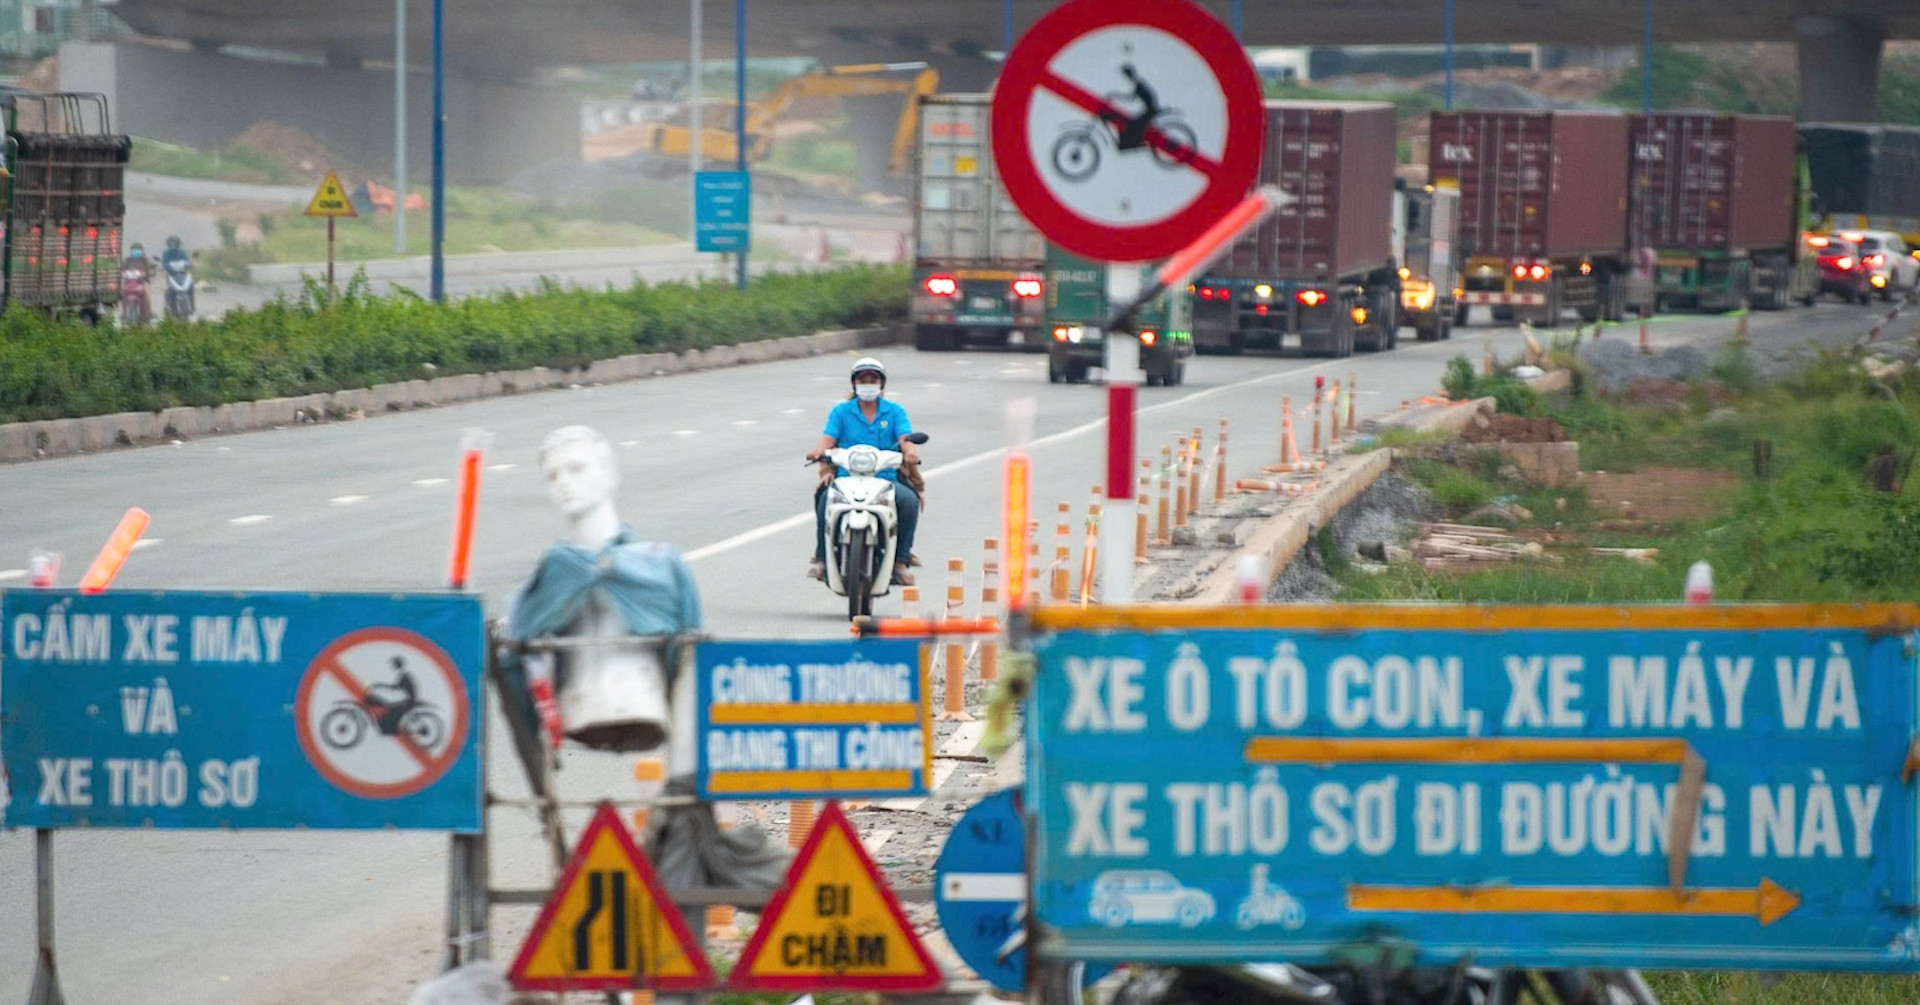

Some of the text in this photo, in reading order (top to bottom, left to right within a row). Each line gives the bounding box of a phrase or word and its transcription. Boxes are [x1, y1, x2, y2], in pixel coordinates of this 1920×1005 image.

[13, 598, 288, 663] CẤM XE MÁY
[120, 677, 179, 734] VÀ
[711, 656, 792, 702] CÔNG
[1064, 640, 1862, 737] XE Ô TÔ CON, XE MÁY VÀ
[706, 721, 925, 770] ĐANG THI CÔNG
[39, 749, 260, 808] XE THÔ SƠ
[1065, 763, 1883, 858] XE THÔ SƠ ĐI ĐƯỜNG NÀY
[815, 884, 850, 917] ĐI
